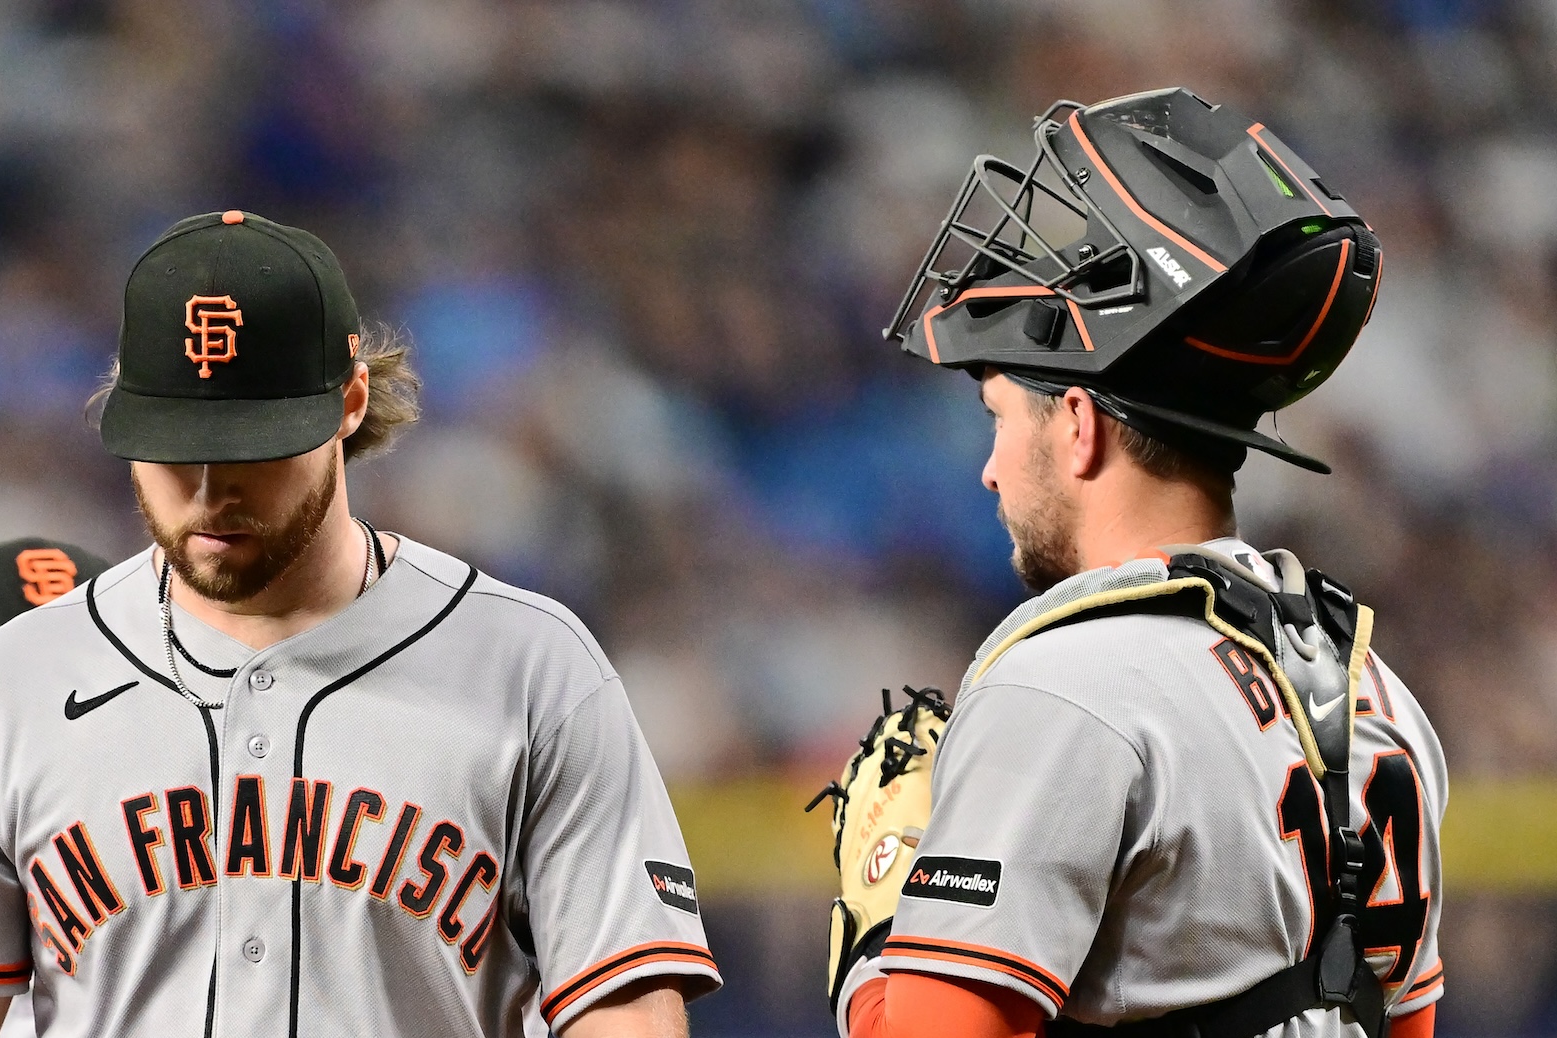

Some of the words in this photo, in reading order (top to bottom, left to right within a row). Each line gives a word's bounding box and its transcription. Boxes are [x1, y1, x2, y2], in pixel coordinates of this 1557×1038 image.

[185, 294, 244, 379] SF
[26, 820, 128, 977] SAN
[928, 869, 997, 894] Airwallex
[1277, 749, 1431, 988] 14
